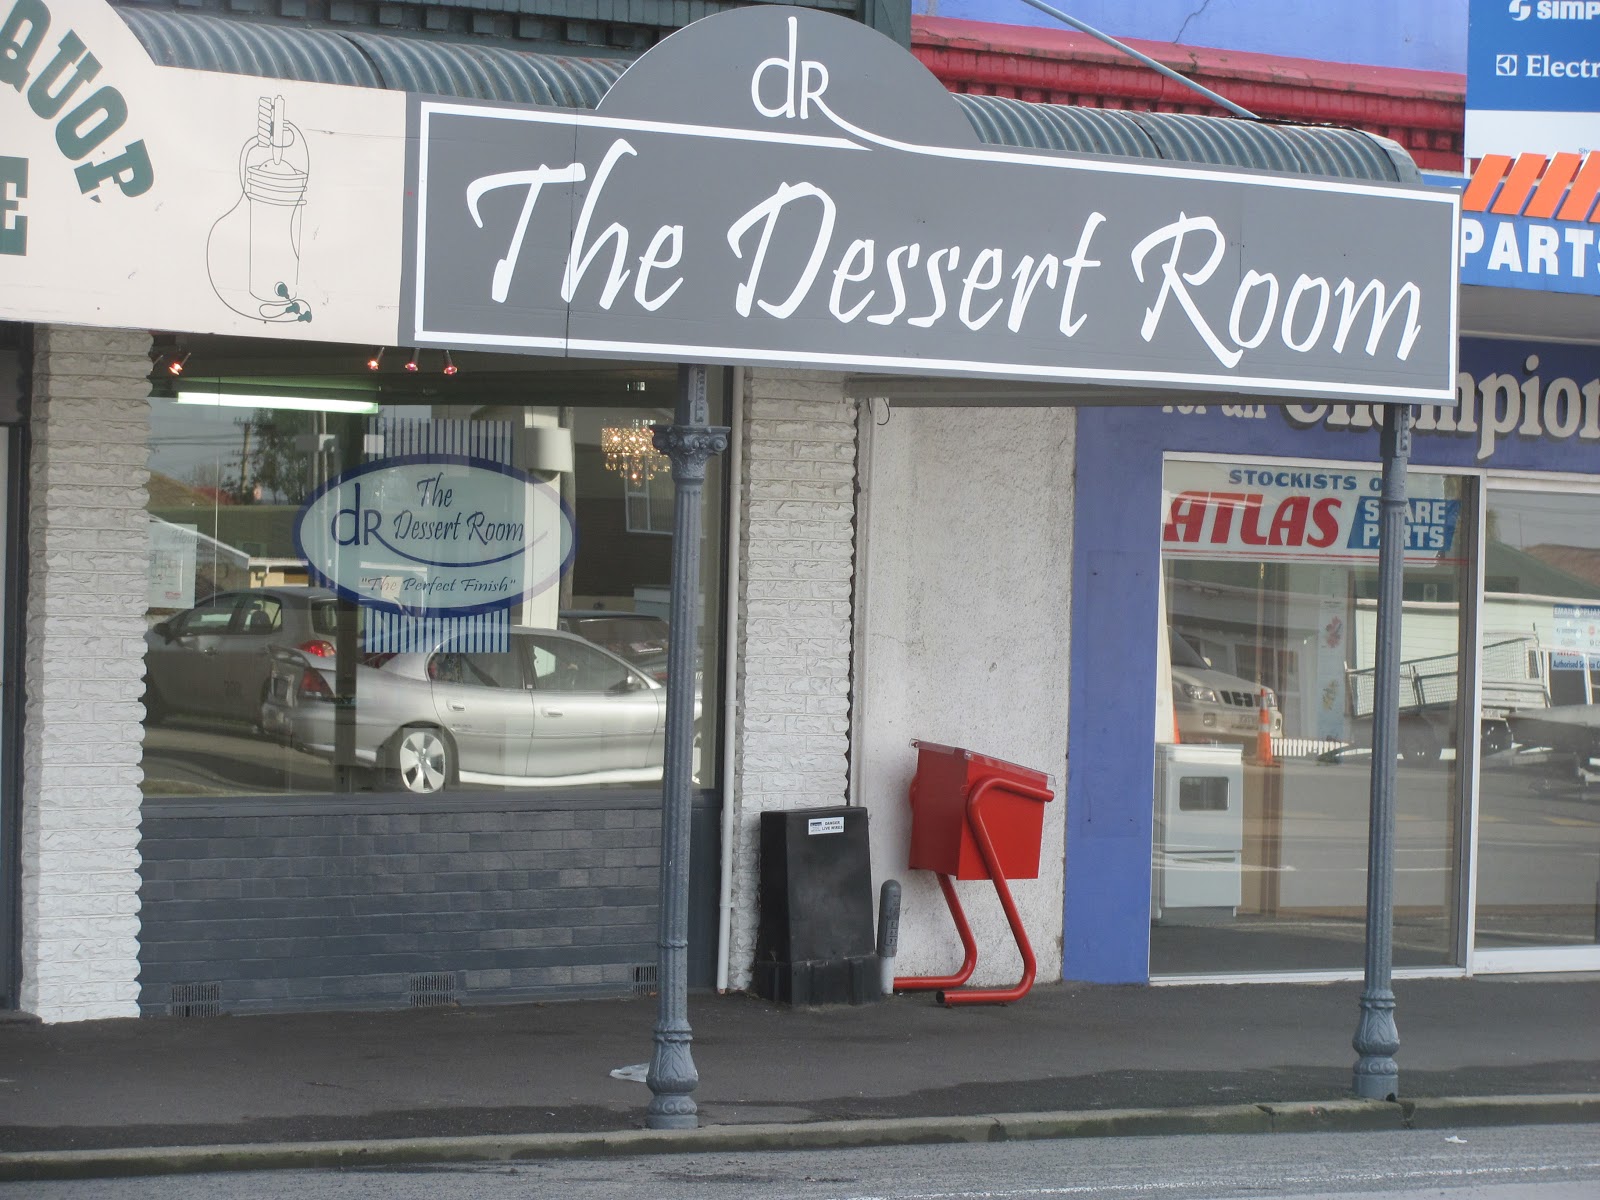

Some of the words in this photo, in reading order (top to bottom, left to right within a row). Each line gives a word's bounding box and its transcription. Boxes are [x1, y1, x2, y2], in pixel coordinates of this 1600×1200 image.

[466, 138, 684, 312] The
[727, 181, 1106, 338] Dessert
[1131, 211, 1421, 369] Room
[1460, 218, 1600, 279] PART
[416, 472, 454, 508] The
[1228, 469, 1358, 491] STOCKISTS
[393, 509, 462, 541] Dessert
[466, 510, 525, 546] Room
[1163, 490, 1342, 549] ATLAS
[1364, 500, 1446, 525] SARE
[1363, 524, 1445, 548] PRTS
[361, 577, 398, 592] "The
[403, 577, 457, 596] Perfect
[461, 576, 517, 592] Finish"
